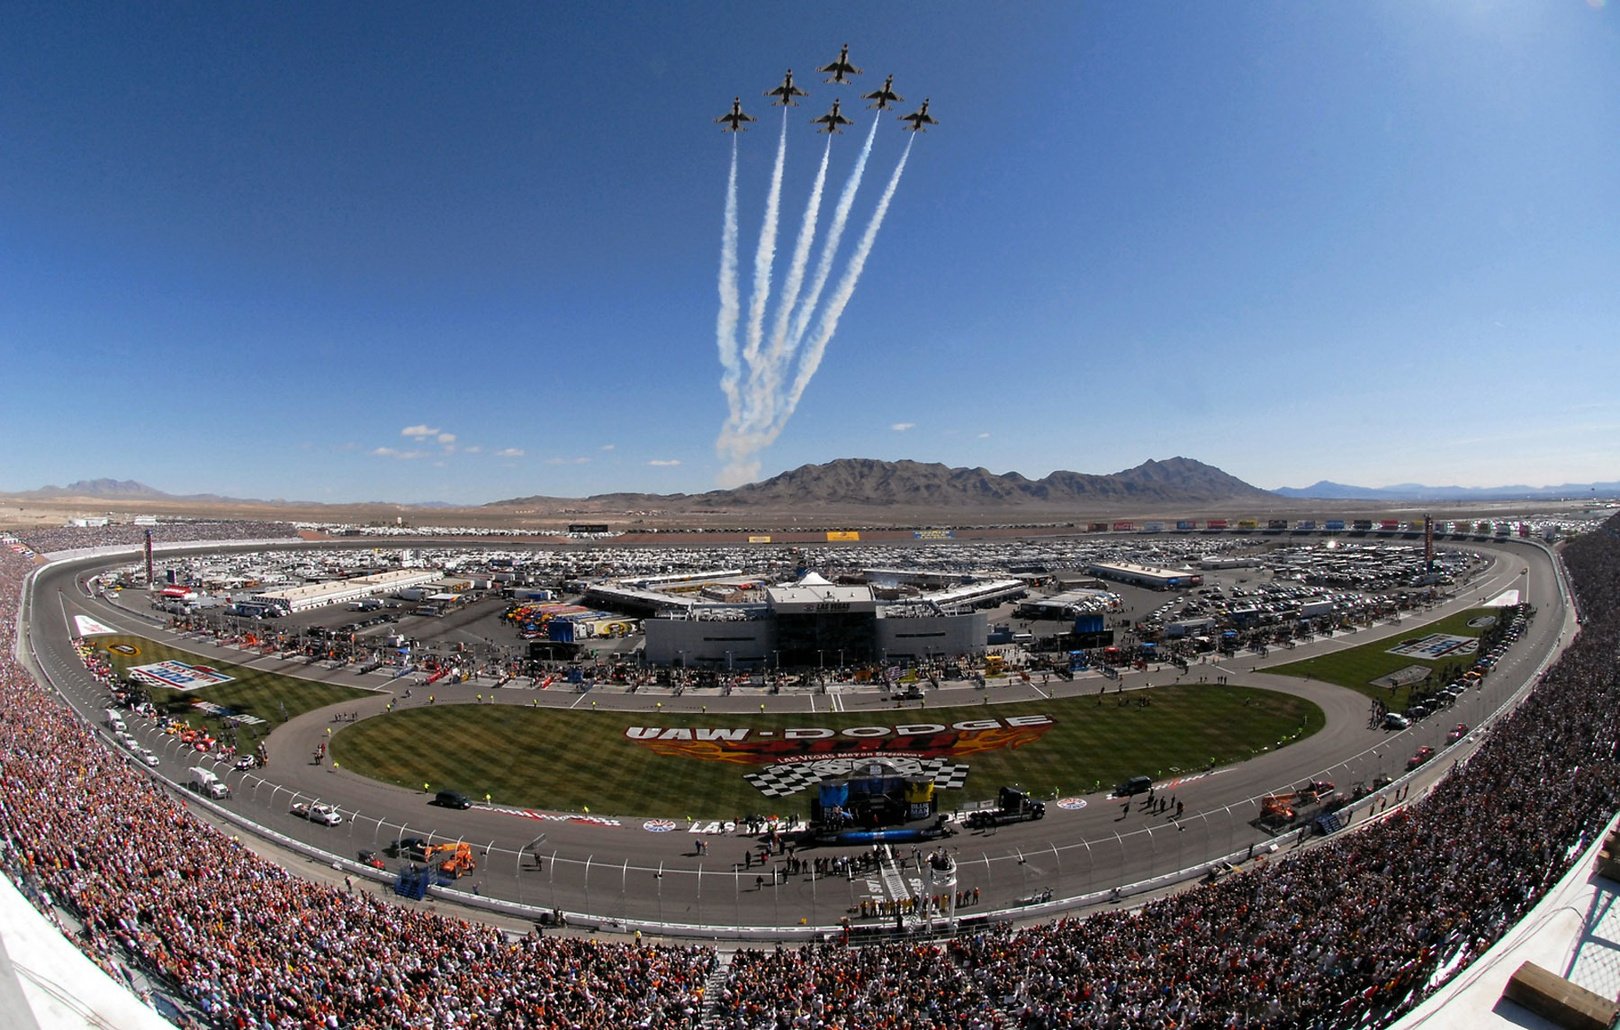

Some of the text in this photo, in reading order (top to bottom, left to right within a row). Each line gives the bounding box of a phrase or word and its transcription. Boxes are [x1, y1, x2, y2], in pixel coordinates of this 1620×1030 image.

[625, 726, 750, 741] UAW
[784, 715, 1053, 739] DODGE
[777, 756, 799, 764] LAS
[800, 753, 836, 762] VEGAS
[688, 821, 736, 834] LAS
